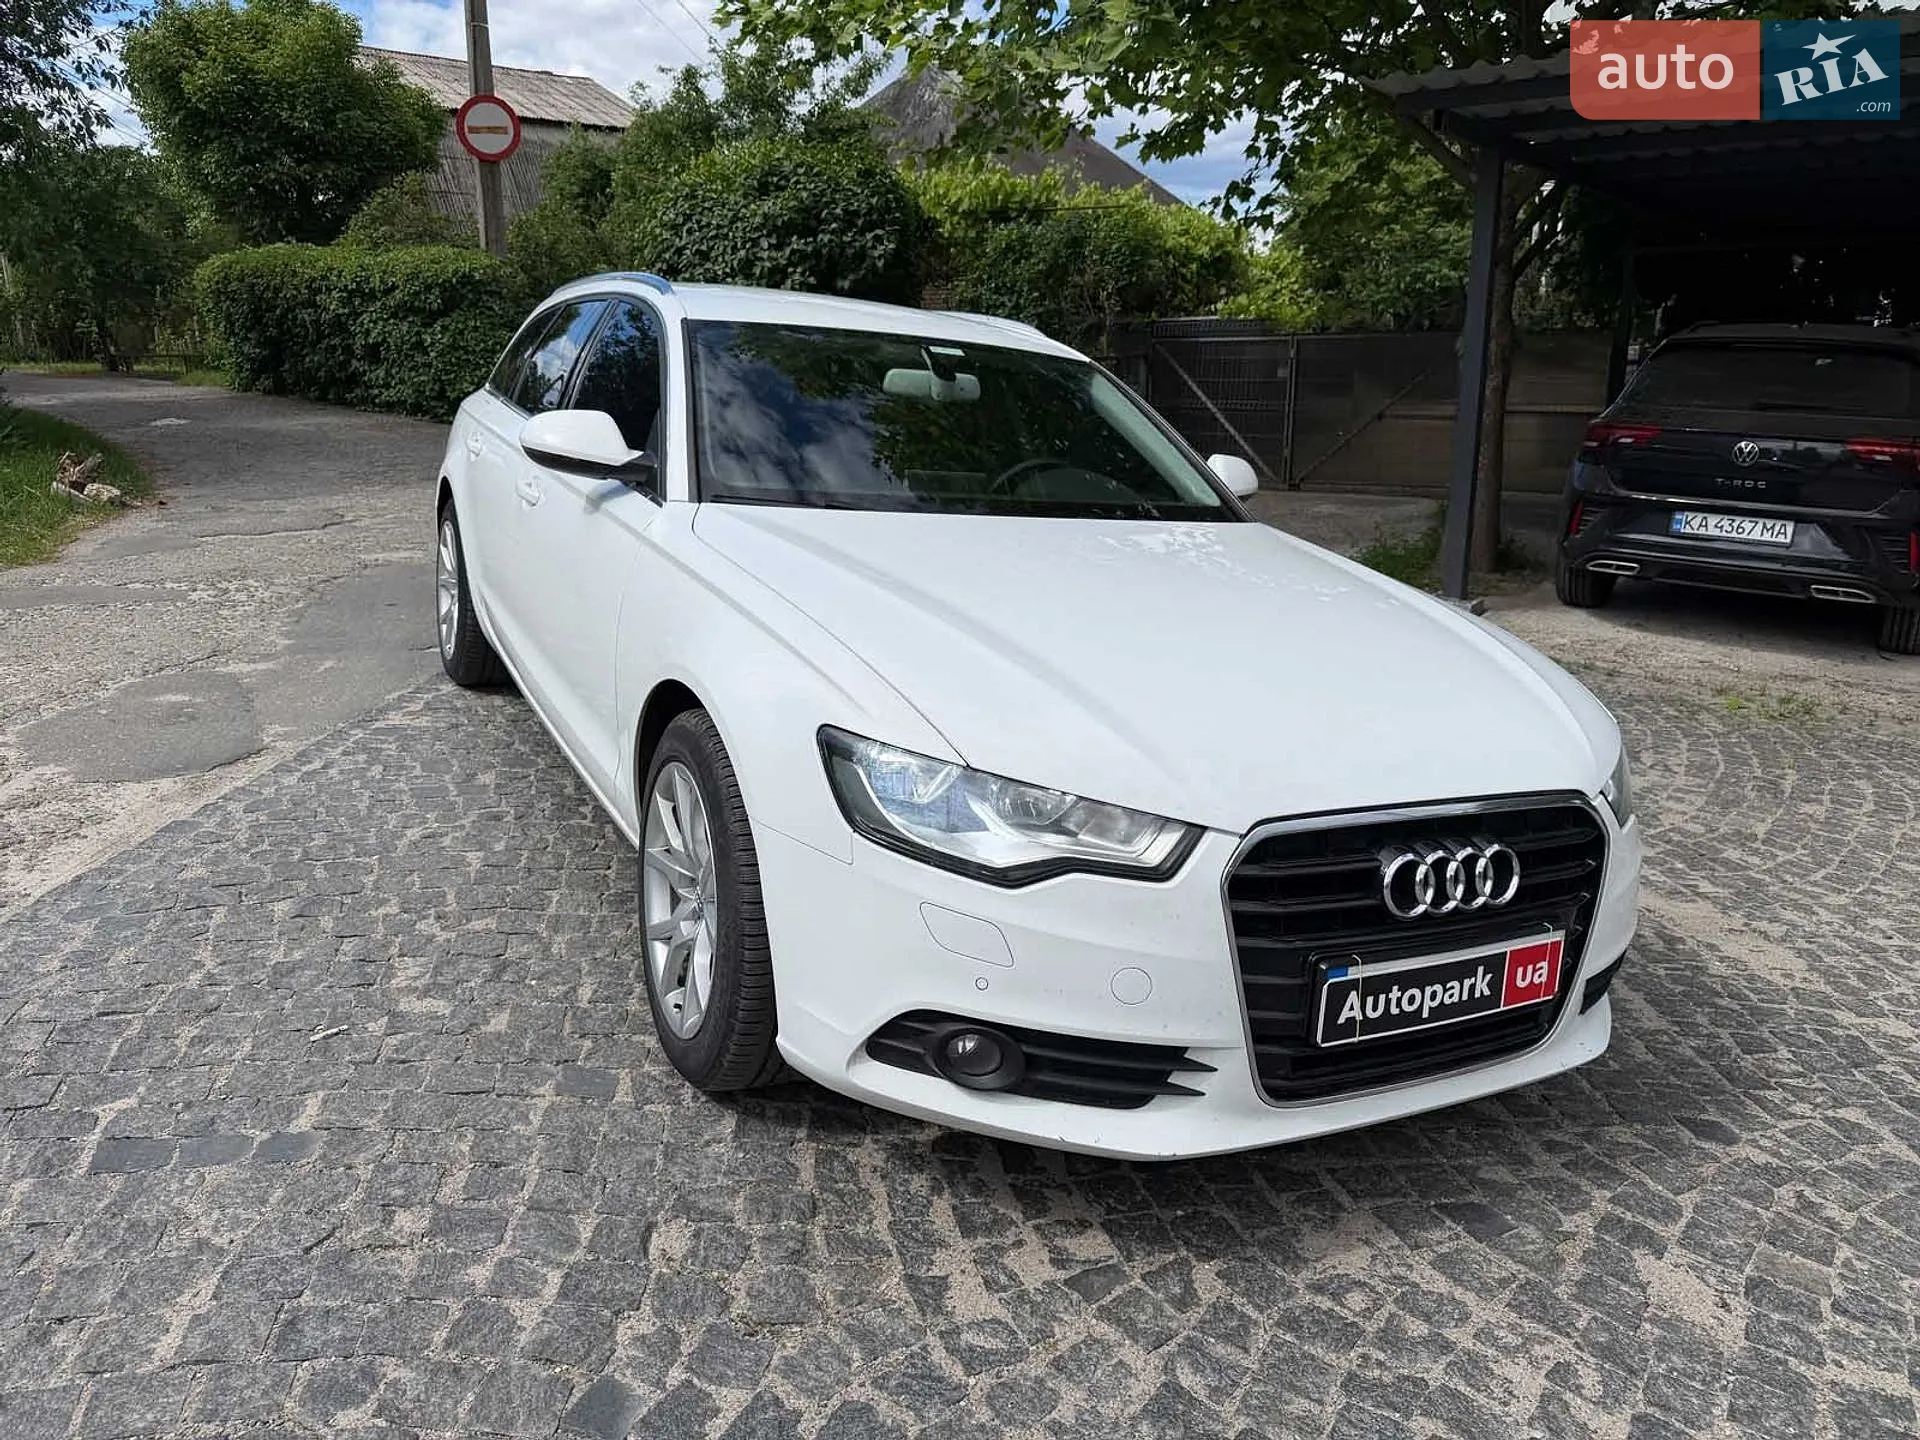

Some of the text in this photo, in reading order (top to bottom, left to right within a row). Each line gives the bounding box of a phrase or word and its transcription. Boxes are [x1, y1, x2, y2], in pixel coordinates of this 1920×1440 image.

[1683, 513, 1709, 532] KA
[1714, 516, 1759, 536] 4367
[1760, 521, 1787, 539] MA
[1337, 960, 1549, 1024] Autopark ua
